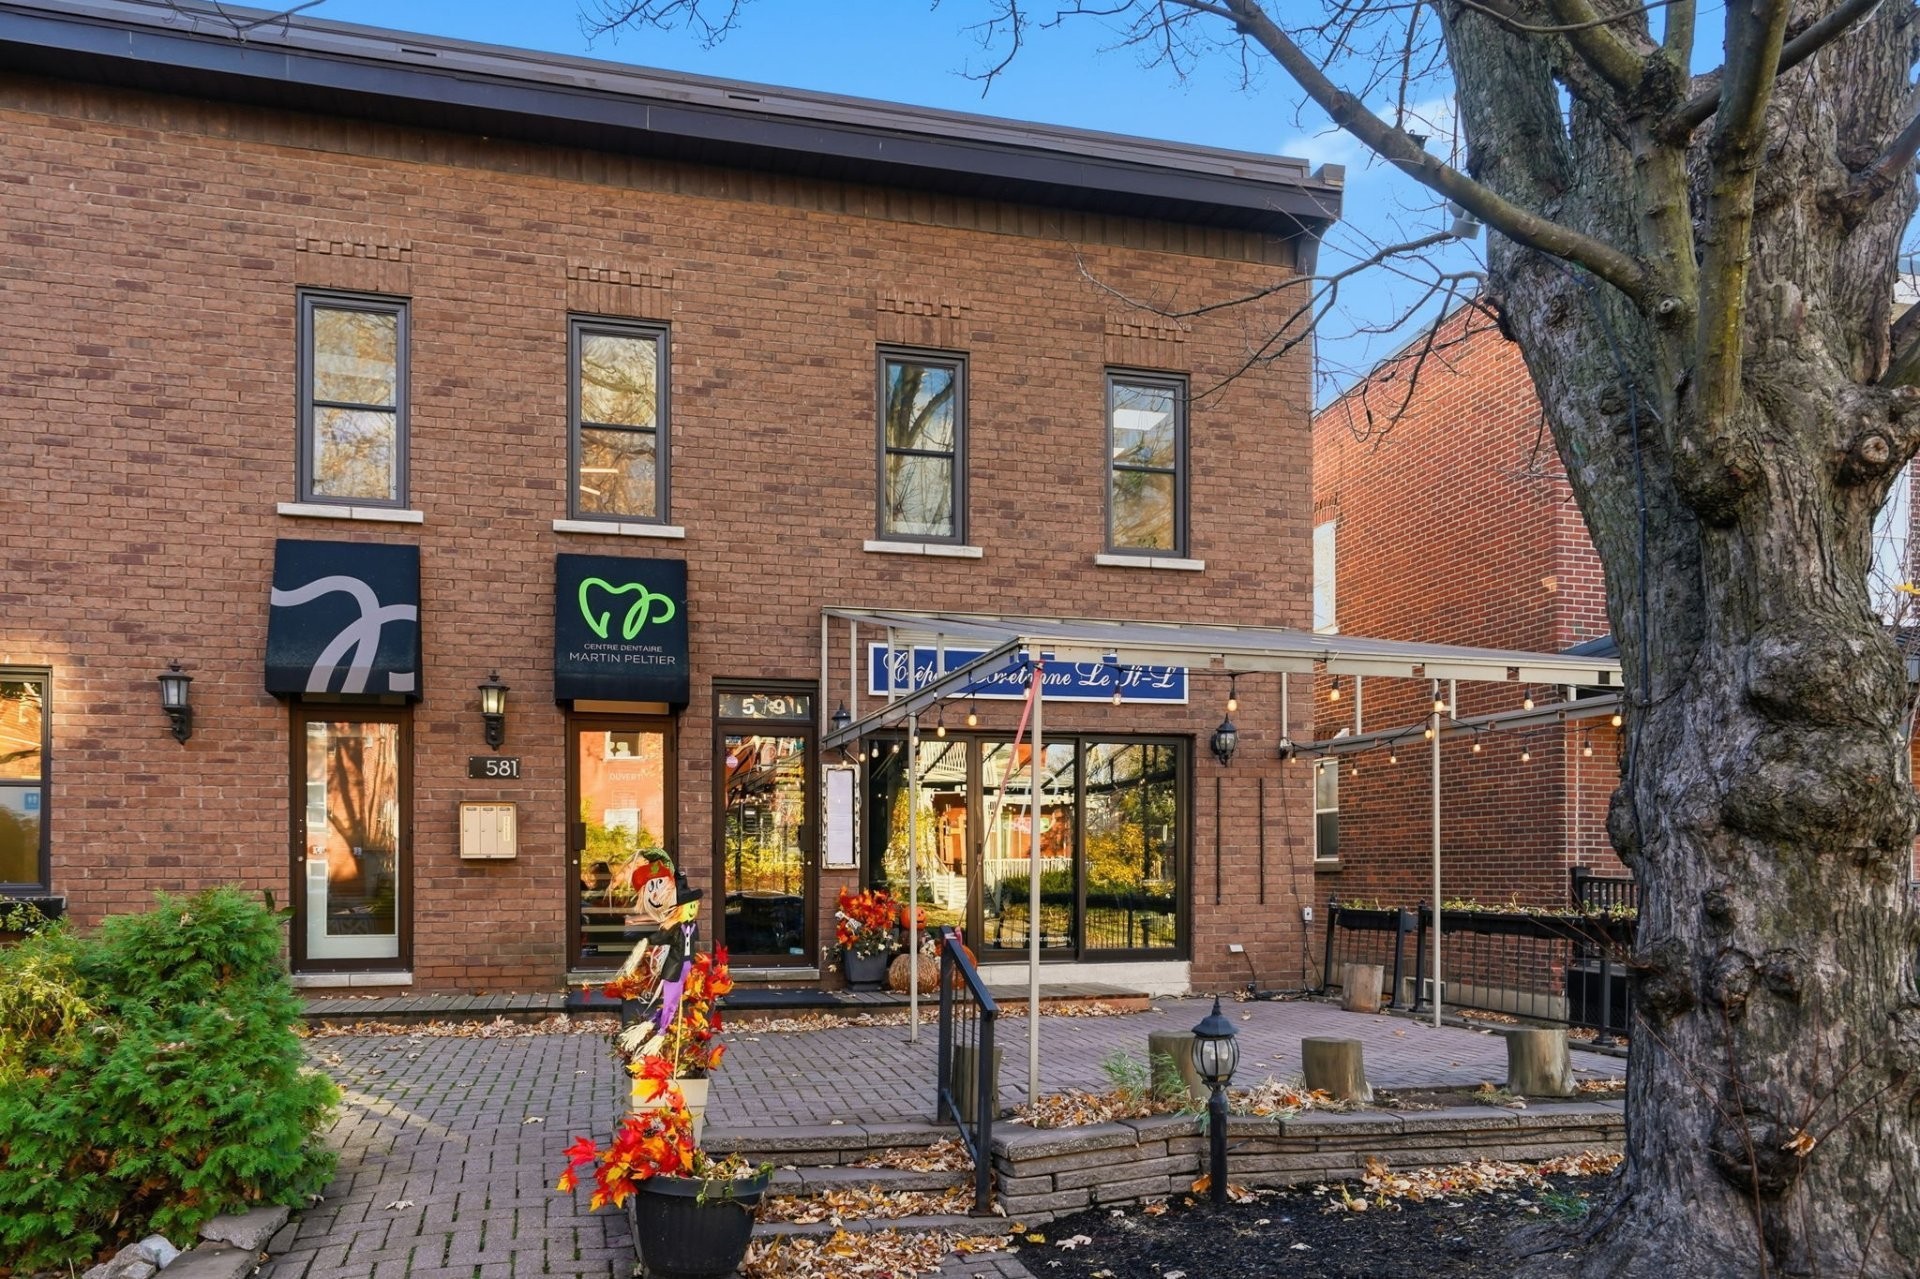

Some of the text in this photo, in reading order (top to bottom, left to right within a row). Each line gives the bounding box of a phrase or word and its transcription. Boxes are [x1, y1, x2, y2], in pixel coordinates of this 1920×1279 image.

[584, 643, 663, 652] CENTRE DENTAIRE
[569, 652, 676, 665] MARTIN PELTIER
[1075, 662, 1110, 686] Le
[486, 760, 517, 776] 581
